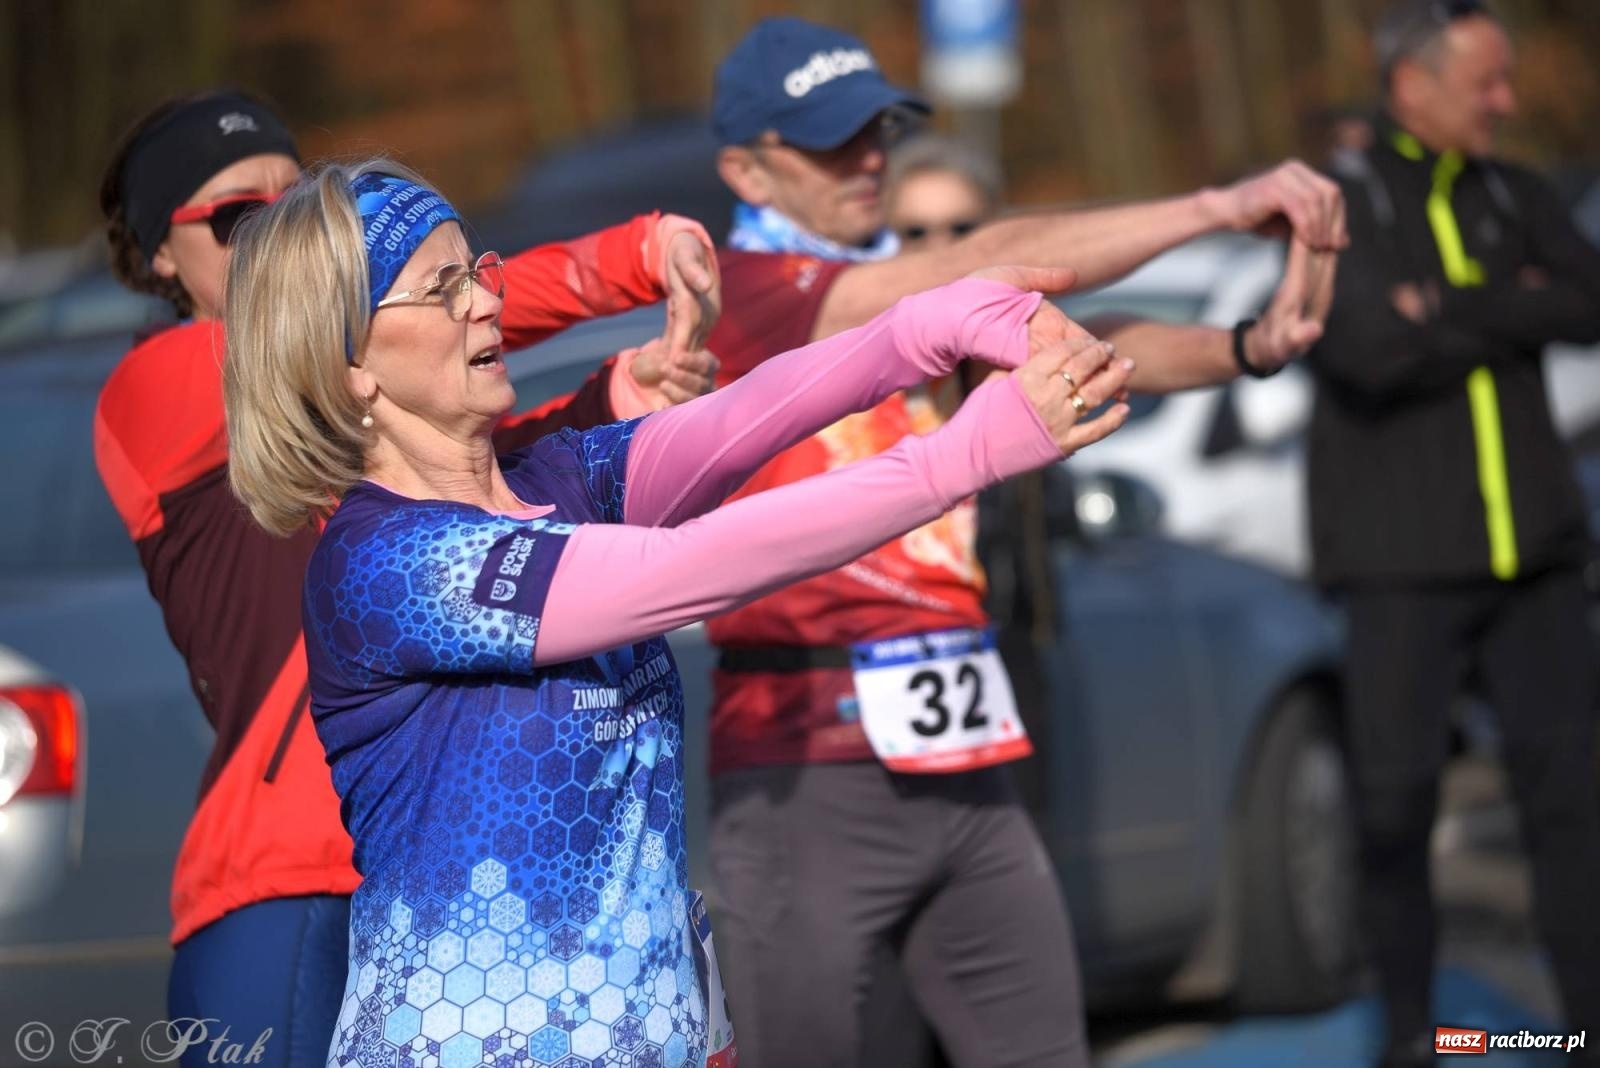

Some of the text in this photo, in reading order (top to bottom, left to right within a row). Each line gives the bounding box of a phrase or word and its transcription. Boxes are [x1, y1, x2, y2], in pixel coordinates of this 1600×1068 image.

[363, 204, 396, 250] IMOWY
[384, 221, 410, 252] GÓR
[499, 533, 525, 575] DOLNY
[572, 687, 625, 711] ZIMOW
[907, 661, 989, 738] 32
[594, 714, 619, 742] GÓR
